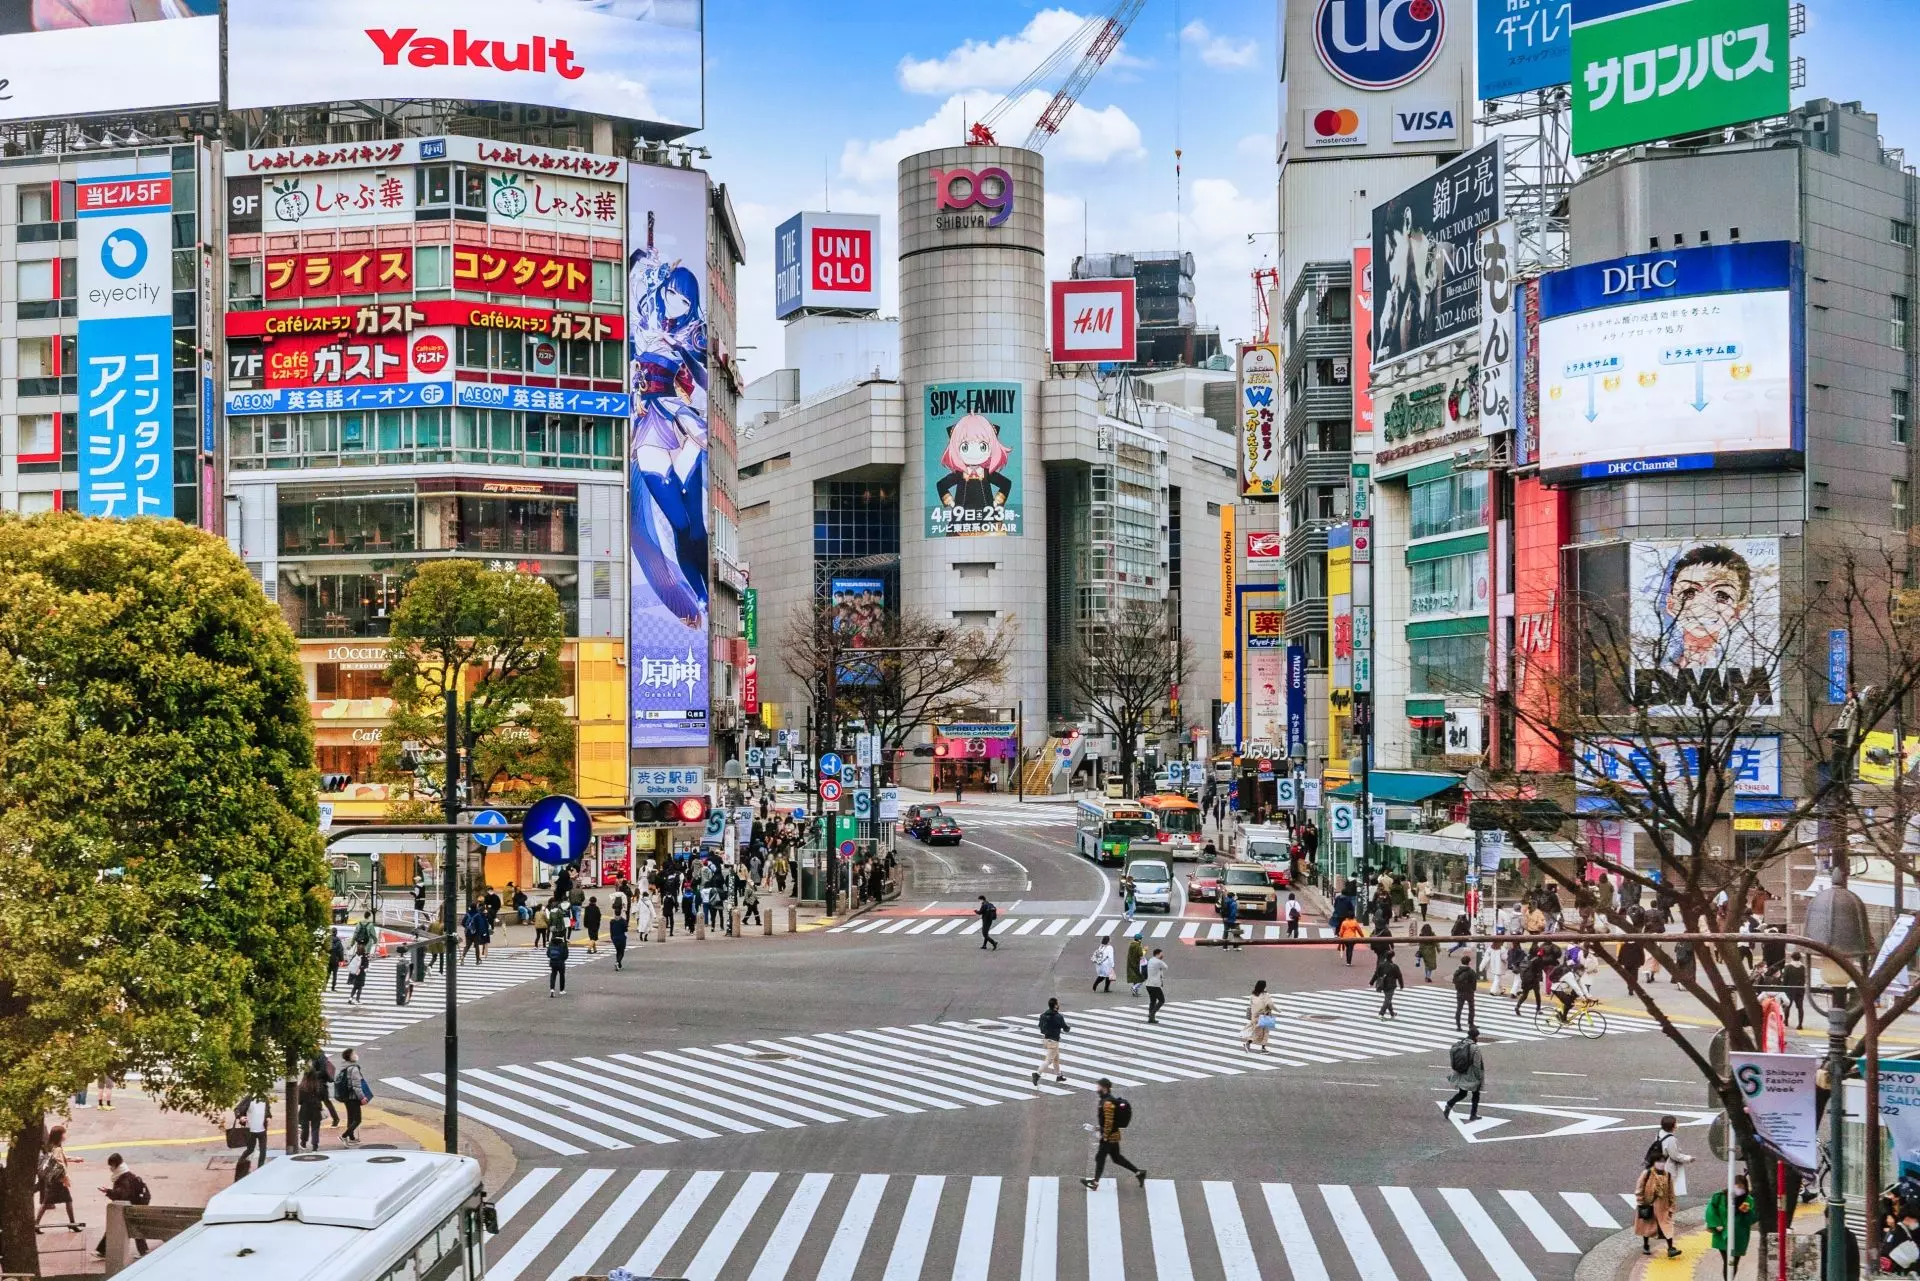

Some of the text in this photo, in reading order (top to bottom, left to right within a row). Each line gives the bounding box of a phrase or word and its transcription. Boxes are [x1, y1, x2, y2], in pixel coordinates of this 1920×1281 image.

[364, 28, 585, 80] Yakult
[1583, 23, 1774, 112] サロンパス
[1396, 111, 1454, 131] VISA
[422, 141, 444, 158] 寿司
[1315, 136, 1358, 145] mastercard
[248, 142, 405, 171] しゃぶしゃぶバイキング
[477, 143, 621, 178] しゃぶしゃぶバイキング
[86, 182, 162, 206] 当ビル5F
[315, 178, 404, 212] しゃぶ葉
[930, 167, 1014, 228] 109
[1432, 155, 1494, 223] 錦戸亮
[232, 195, 259, 215] 9F
[535, 184, 617, 223] しゃぶ葉
[936, 215, 985, 230] SHIBUYA
[1436, 207, 1490, 244] LIVE TOUR 2021
[781, 229, 796, 263] THE
[818, 236, 860, 258] UNI
[267, 253, 408, 290] プライス
[454, 251, 586, 291] コンタクト
[777, 261, 801, 306] PRIME
[818, 262, 865, 287] QLO
[1602, 259, 1677, 296] DHC
[89, 283, 160, 308] eyecity
[356, 305, 425, 334] ガスト
[552, 313, 612, 342] ガスト
[1073, 307, 1114, 334] H&M
[1482, 228, 1512, 427] もんじゃ
[271, 353, 309, 369] Café
[313, 345, 399, 383] ガスト
[416, 353, 445, 364] ガスト
[1566, 357, 1618, 372] トラネキサム酸
[1665, 345, 1736, 359] トラネキサム酸
[231, 354, 263, 377] 7F
[272, 370, 308, 380] レストラン
[232, 388, 441, 410] AEON 英会話イーオン 6F
[463, 386, 627, 413] AEON 英会話イーオン
[135, 354, 160, 514] コンタクト
[1608, 459, 1678, 473] DHC Channel
[639, 645, 702, 704] 原神
[1293, 655, 1301, 689] MIZUHO
[746, 678, 755, 702] アコム
[352, 728, 383, 744] Café
[964, 738, 987, 757] 109
[637, 770, 698, 785] 渋谷駅前
[646, 786, 675, 795] Shibuya
[1765, 1069, 1807, 1077] Shibuya
[1765, 1077, 1804, 1085] Fashion
[1877, 1073, 1915, 1083] OKYO
[1765, 1085, 1795, 1093] Week
